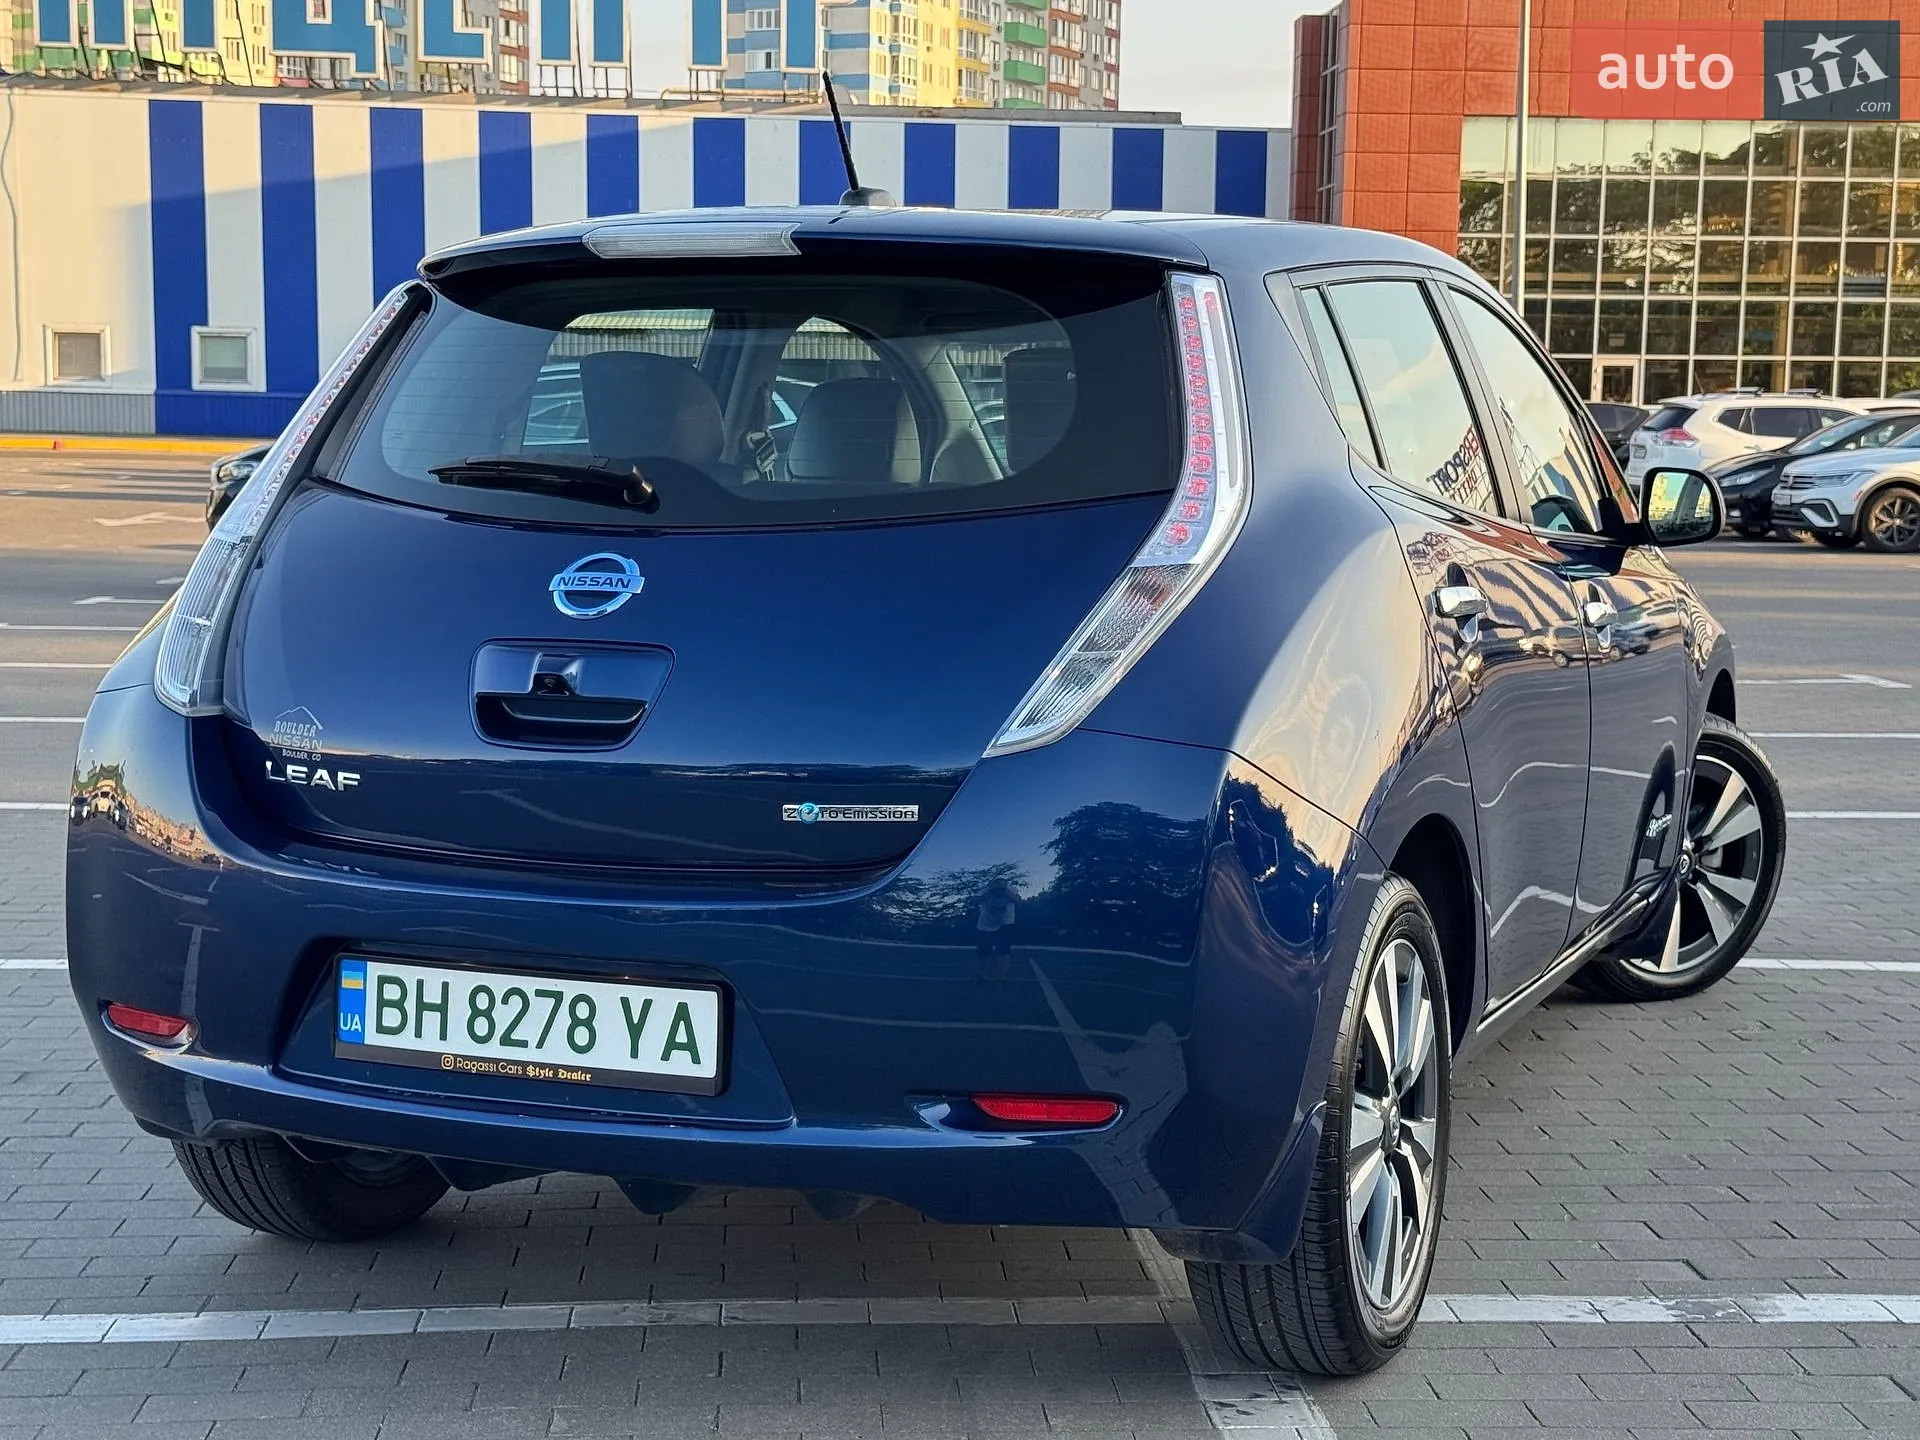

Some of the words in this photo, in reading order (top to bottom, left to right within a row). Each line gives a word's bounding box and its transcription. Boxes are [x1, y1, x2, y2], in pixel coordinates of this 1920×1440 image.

[557, 576, 631, 589] NISSAN
[273, 720, 317, 737] BOULDER
[269, 733, 323, 751] NISSAN
[265, 760, 361, 791] LEAF
[340, 1013, 363, 1033] UA
[375, 974, 449, 1042] BH
[466, 984, 597, 1055] 8278
[619, 996, 702, 1065] YA
[456, 1057, 497, 1074] Ragassi
[498, 1062, 523, 1075] Cars
[557, 1068, 592, 1082] Dealer
